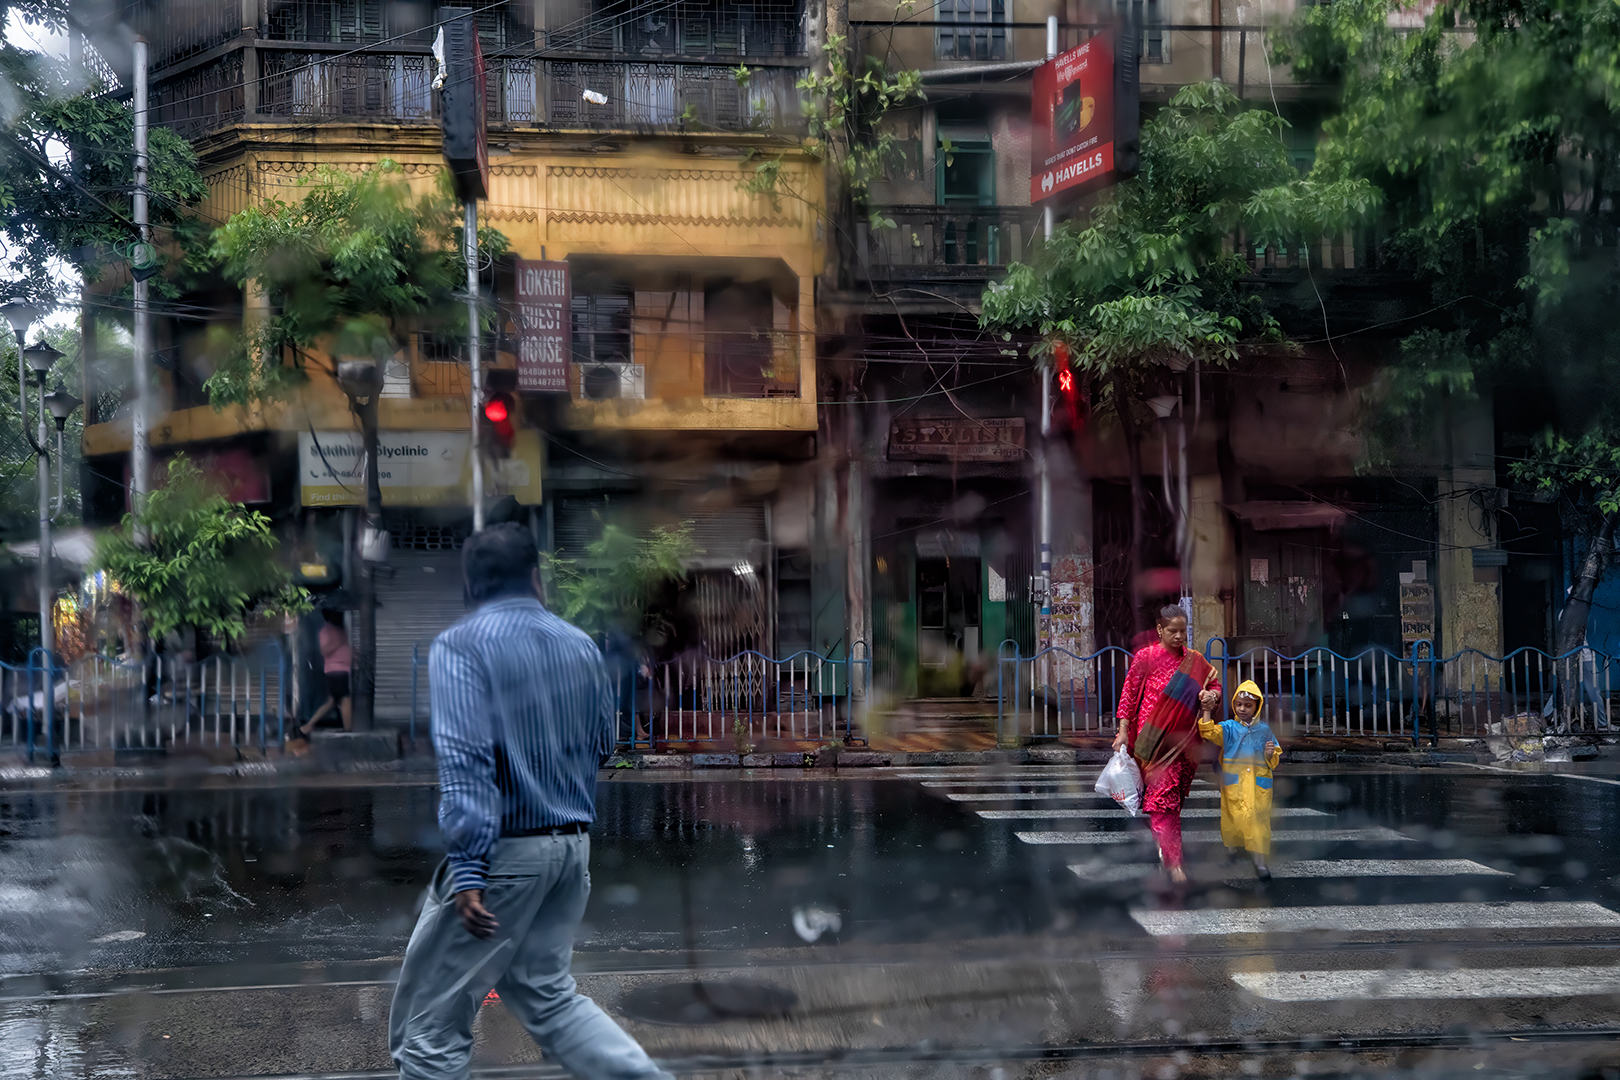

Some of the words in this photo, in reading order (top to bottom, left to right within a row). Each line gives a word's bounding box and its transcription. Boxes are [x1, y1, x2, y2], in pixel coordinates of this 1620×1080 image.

[1055, 51, 1076, 70] HAVELLS
[1077, 43, 1090, 58] WIRE
[1076, 140, 1089, 152] CATCH
[1089, 135, 1098, 145] FIRE
[1056, 153, 1102, 184] HAVELLS
[519, 269, 565, 296] LOKKHI
[519, 303, 562, 329] GUEST
[521, 336, 563, 363] HOUSE
[376, 445, 429, 459] olyclinic
[311, 493, 331, 501] Find
